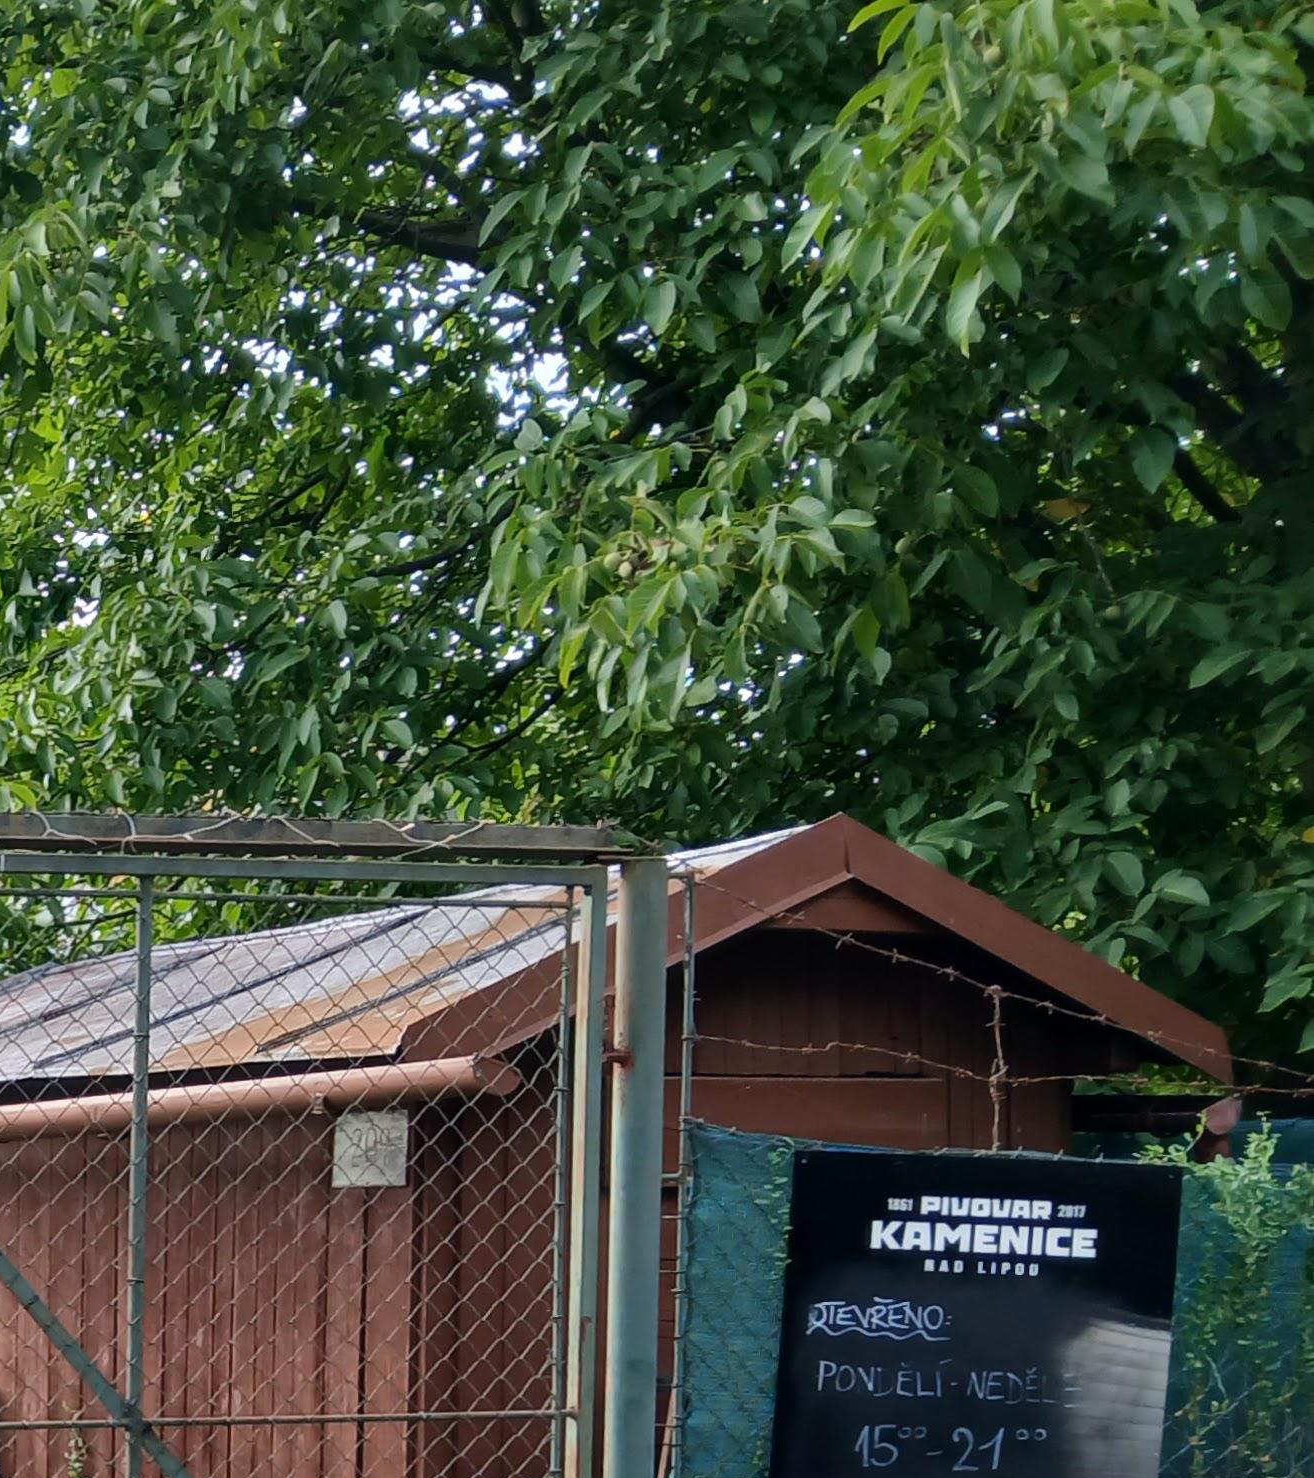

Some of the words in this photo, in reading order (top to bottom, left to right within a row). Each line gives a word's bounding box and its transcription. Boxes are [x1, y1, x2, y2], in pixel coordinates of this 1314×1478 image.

[920, 1195, 1053, 1220] PIVOVAR
[870, 1219, 1099, 1259] KAMENICE
[923, 1258, 964, 1274] NAD
[977, 1260, 1039, 1277] LIPOU
